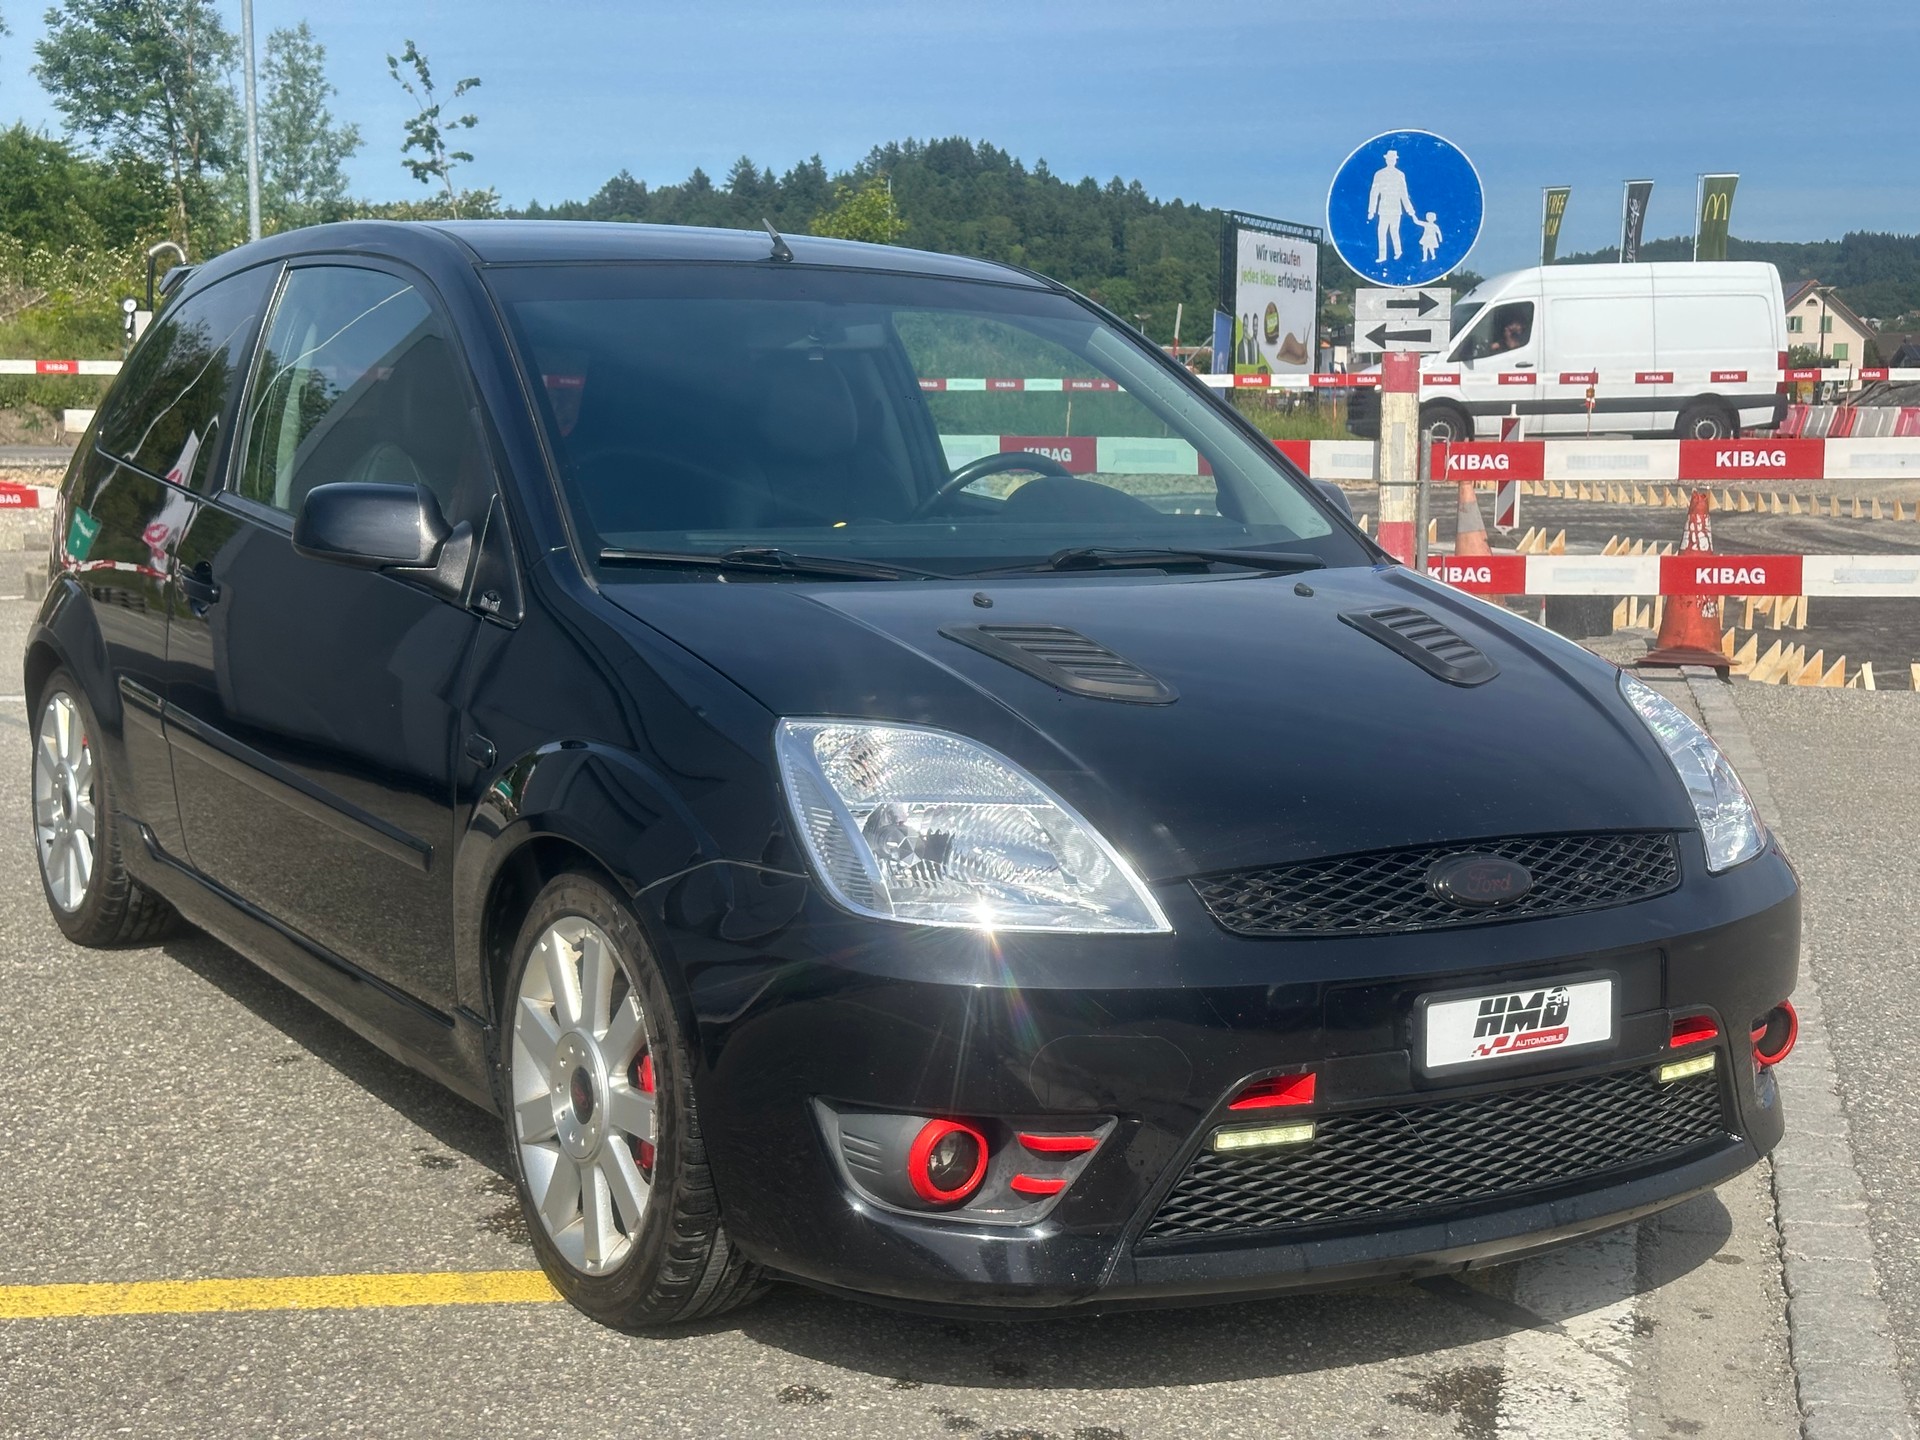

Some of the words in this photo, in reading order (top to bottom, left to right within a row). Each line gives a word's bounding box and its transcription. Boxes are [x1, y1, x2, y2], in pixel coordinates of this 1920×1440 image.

[1256, 244, 1268, 261] Wir
[1269, 248, 1301, 267] verkaufen
[1240, 265, 1259, 286] jedes
[1260, 269, 1277, 286] Haus
[1278, 272, 1313, 293] erfolgreich.
[45, 363, 69, 372] KIBAG
[1242, 376, 1263, 384] KIBAG
[1569, 374, 1590, 382] KIBAG
[1446, 454, 1509, 470] KIBAG
[1715, 450, 1786, 467] KIBAG
[0, 494, 21, 504] BAG
[1428, 567, 1491, 583] KIBAG
[1696, 568, 1766, 584] KIBAG
[1467, 868, 1512, 893] Ford
[1473, 988, 1569, 1038] HMD
[1515, 1033, 1564, 1047] AUTOMOBILE
